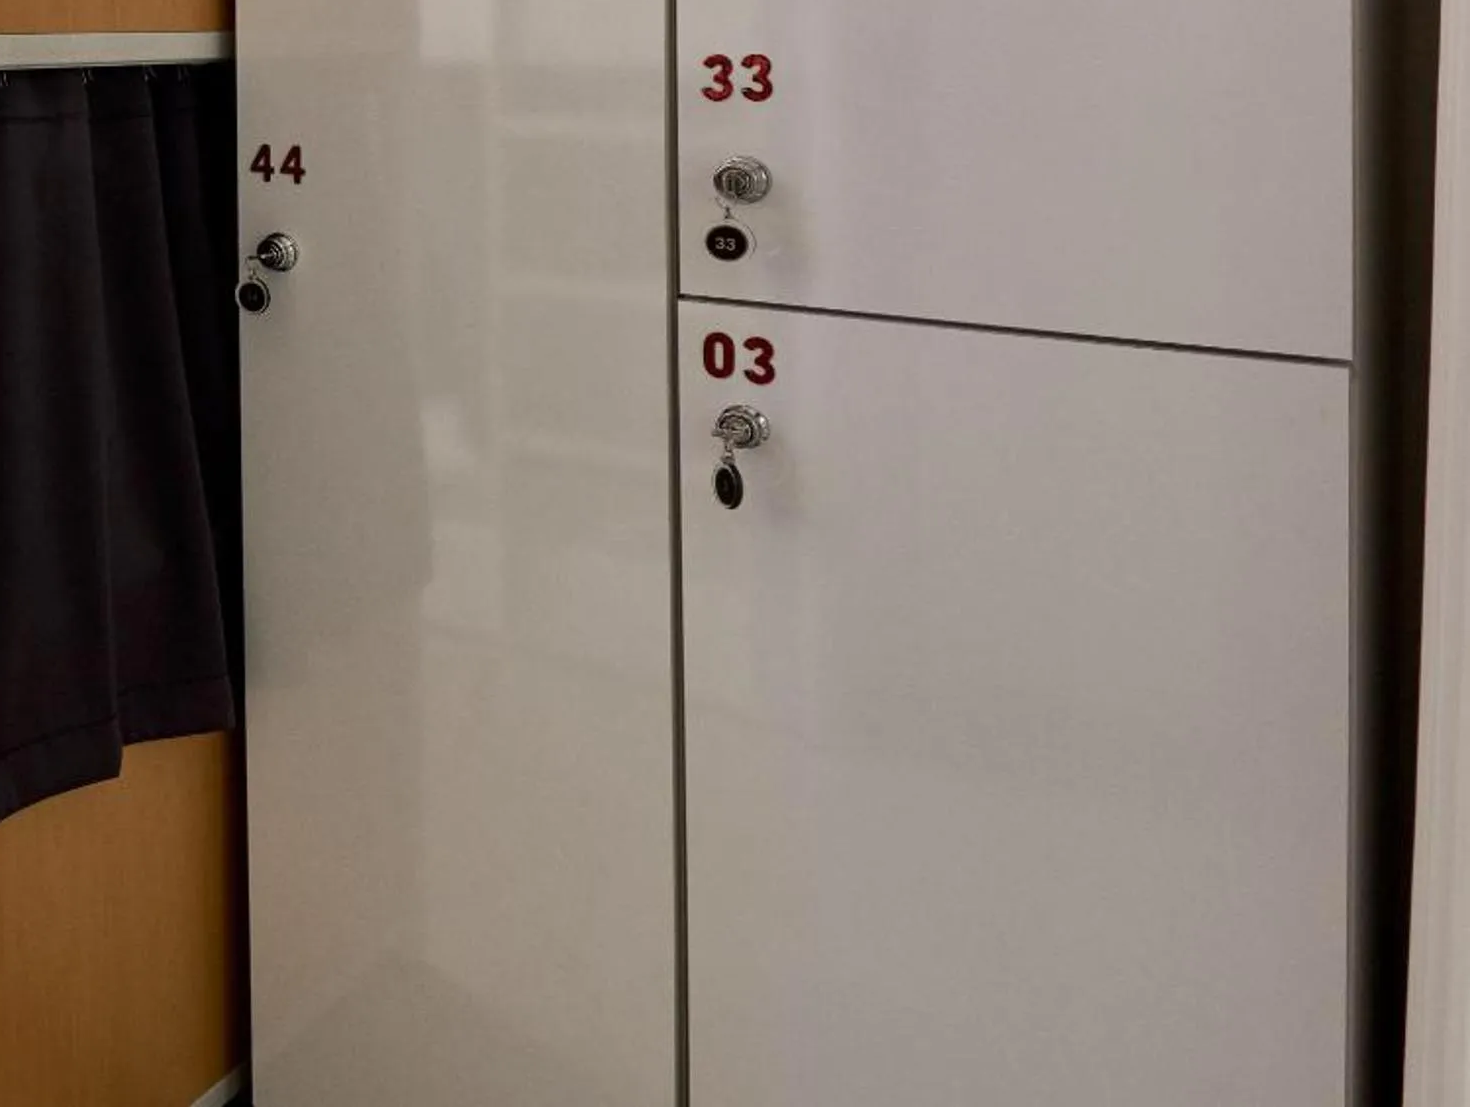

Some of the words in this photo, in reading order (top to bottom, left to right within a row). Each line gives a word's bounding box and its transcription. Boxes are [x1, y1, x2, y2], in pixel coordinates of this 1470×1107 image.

[701, 54, 773, 102] 33
[250, 143, 306, 185] 44
[715, 237, 736, 251] 33
[703, 332, 776, 385] 03
